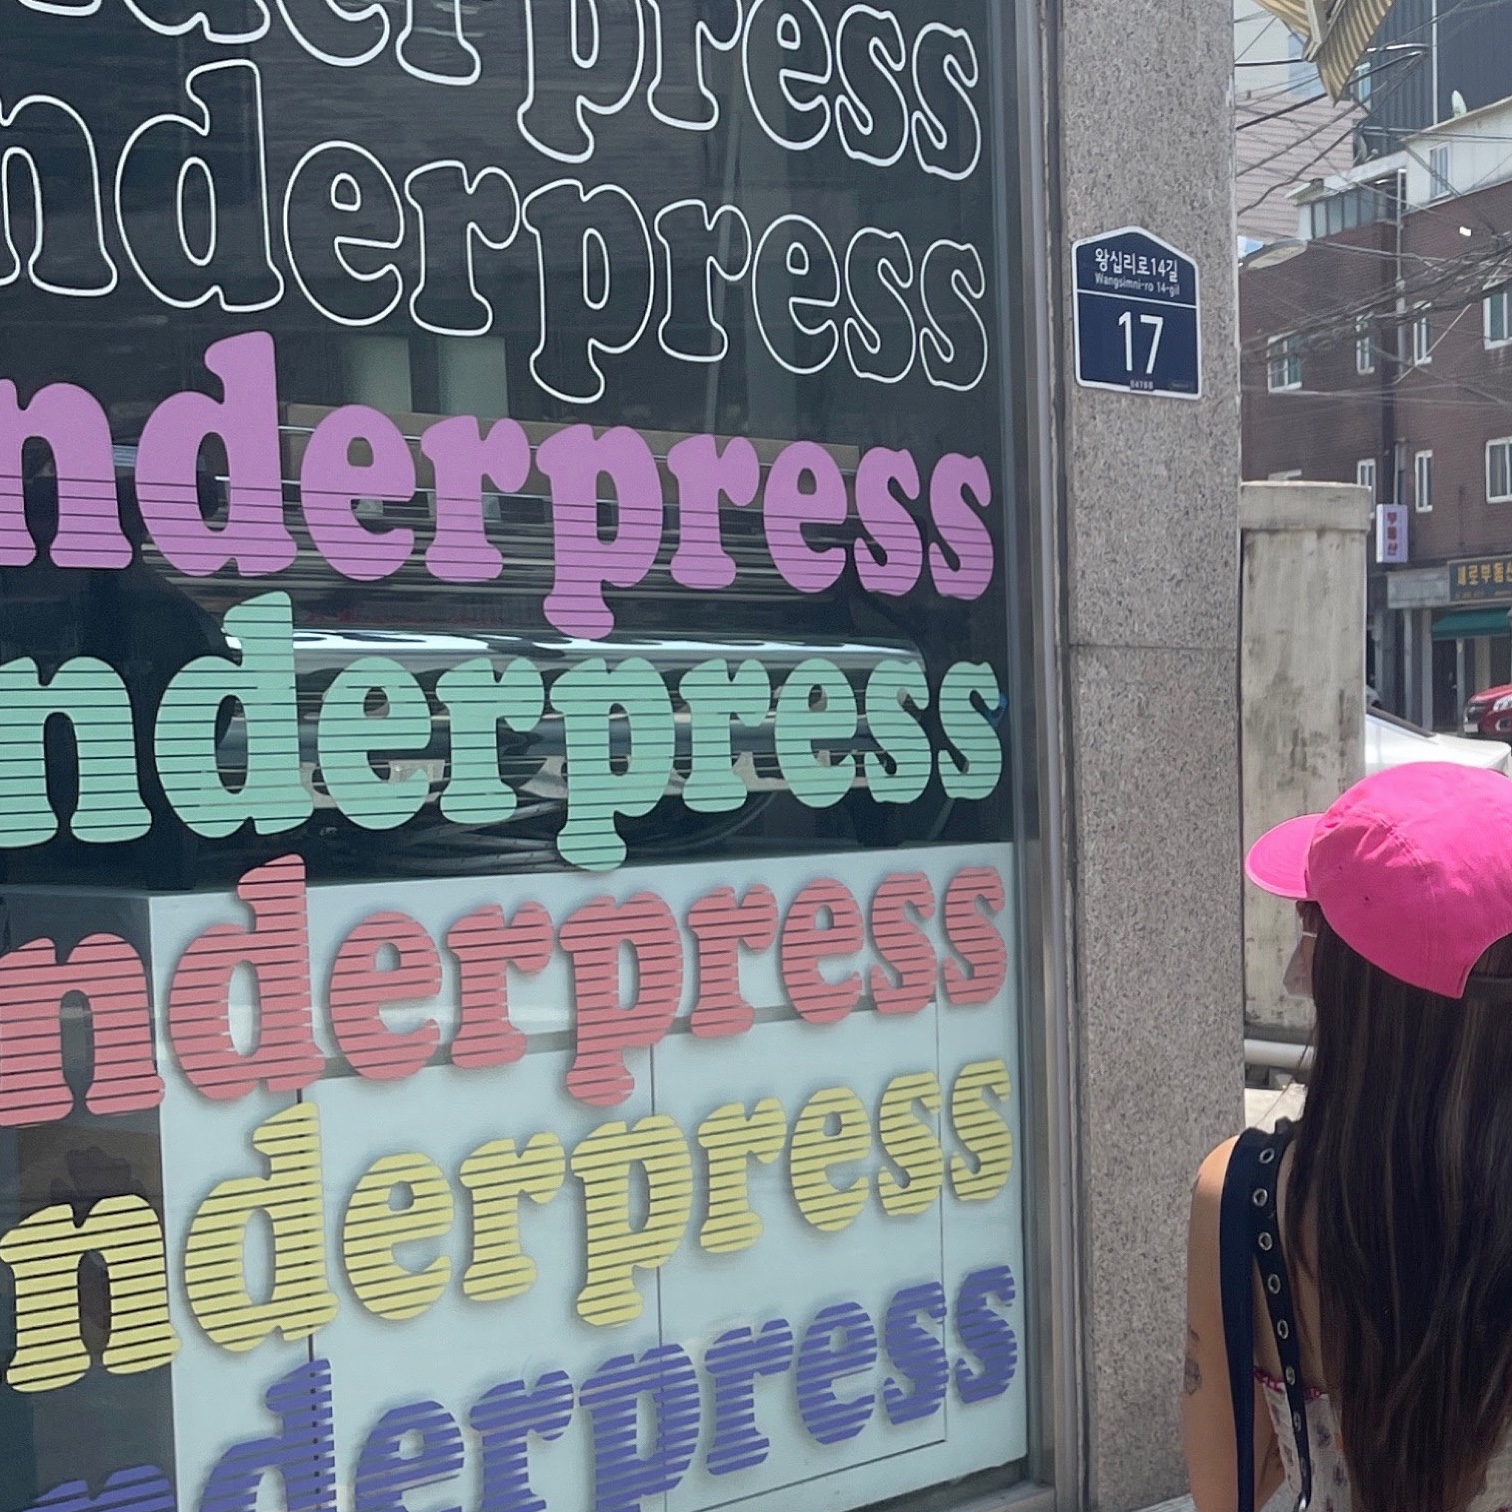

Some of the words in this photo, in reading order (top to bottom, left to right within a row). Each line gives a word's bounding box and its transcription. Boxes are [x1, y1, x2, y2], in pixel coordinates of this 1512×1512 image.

[1094, 247, 1179, 283] 왕십리로14길
[1094, 272, 1154, 292] Wangsimni-ro
[1156, 281, 1181, 298] 14-gil
[1117, 310, 1164, 375] 17
